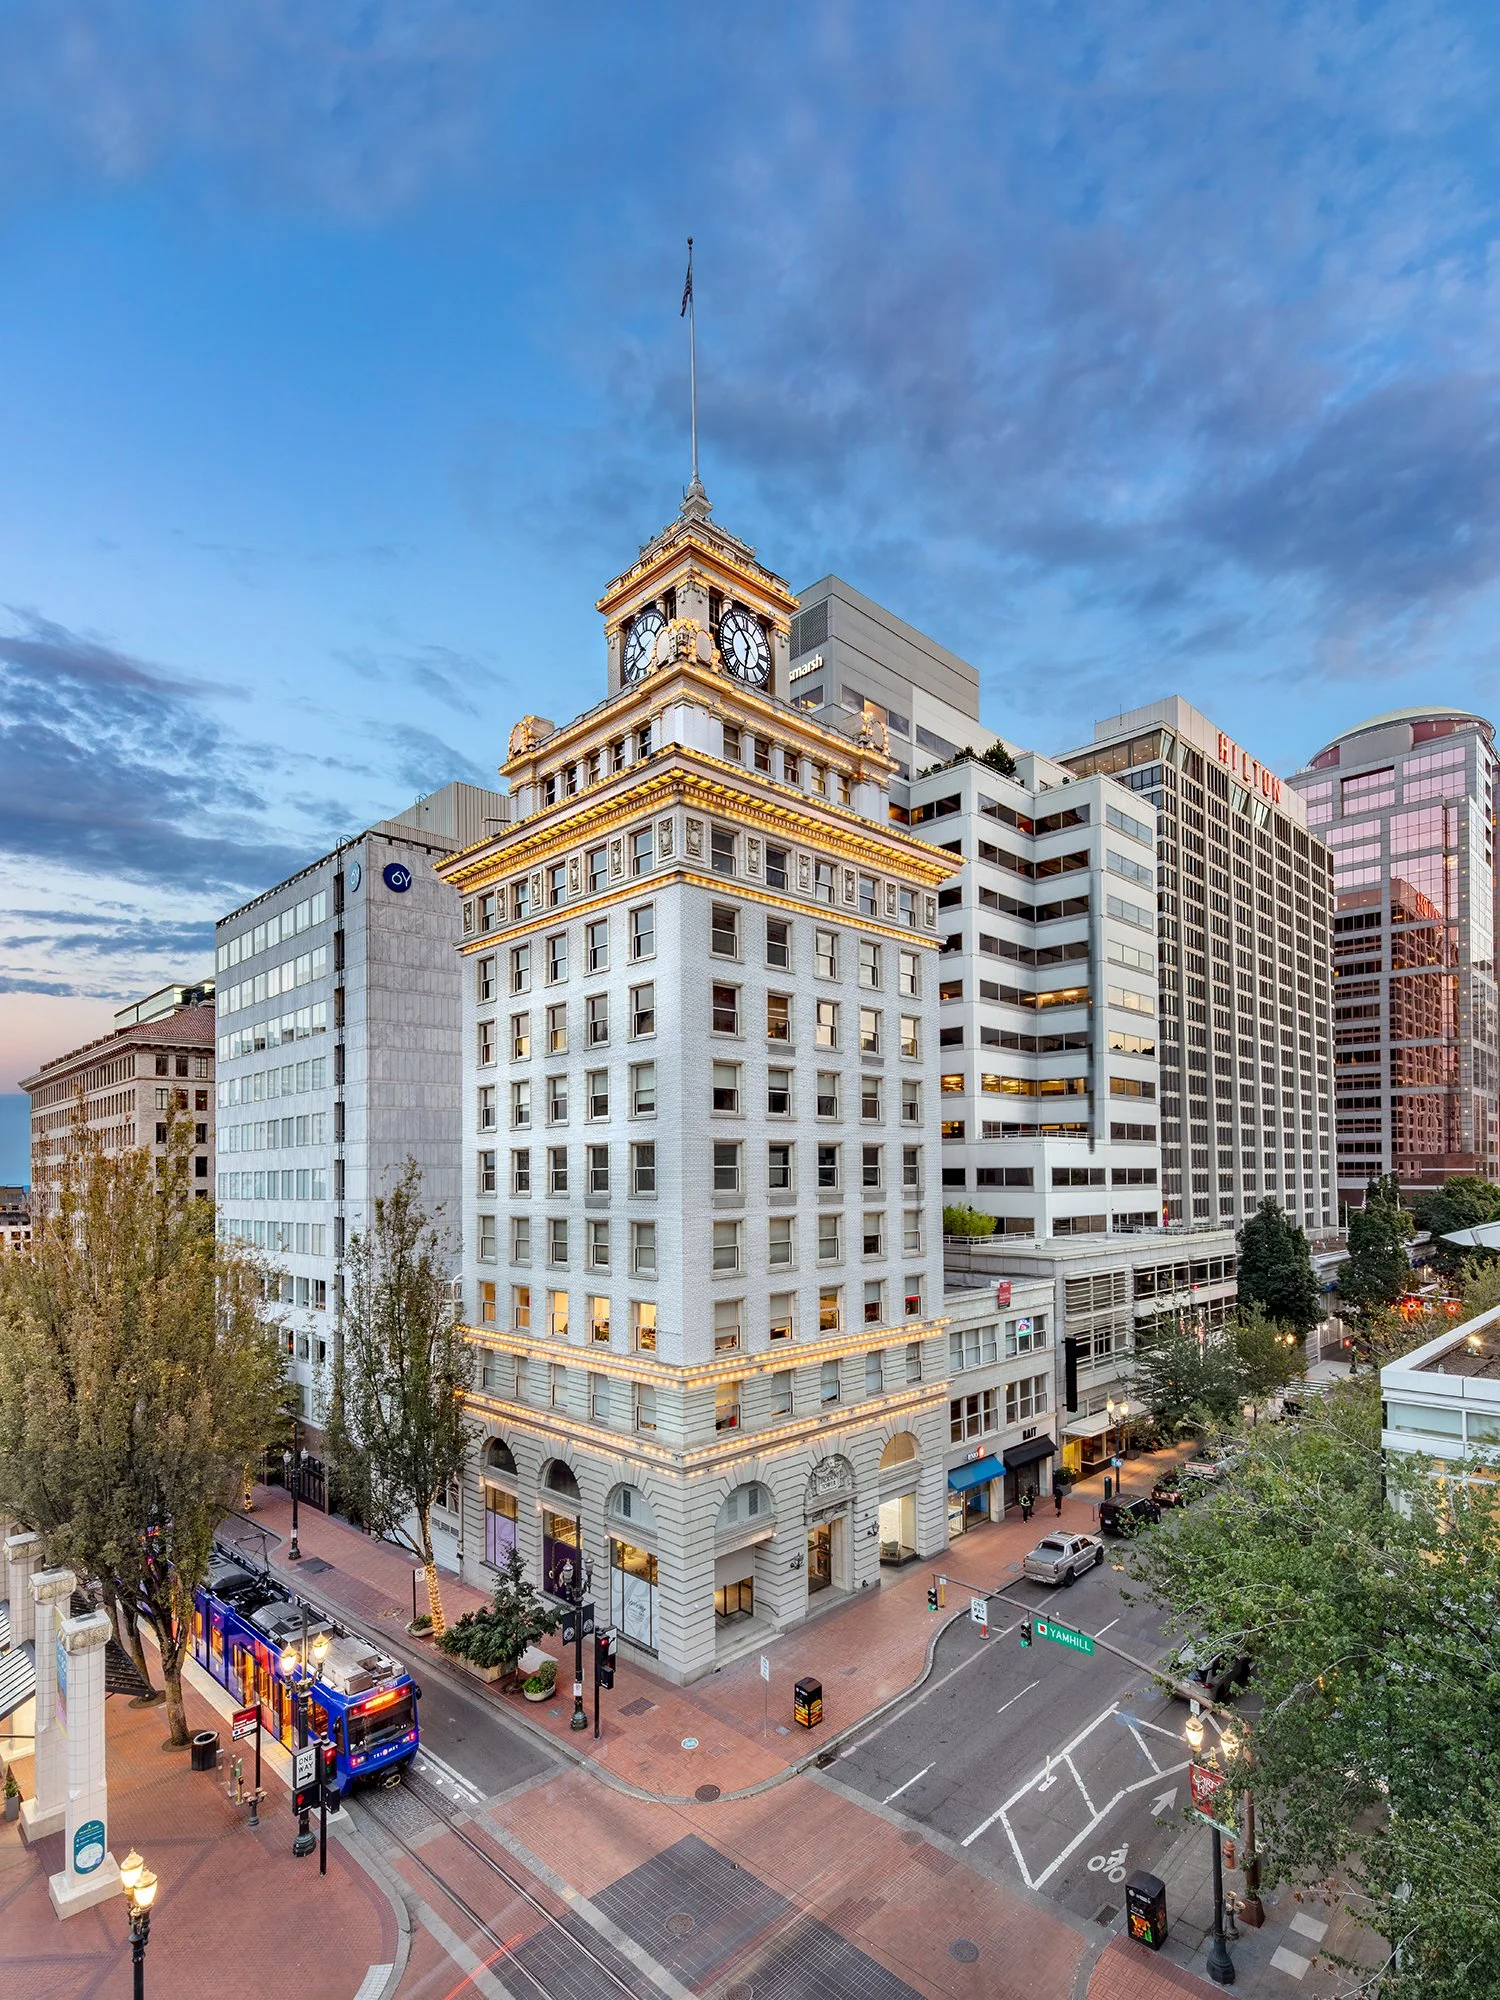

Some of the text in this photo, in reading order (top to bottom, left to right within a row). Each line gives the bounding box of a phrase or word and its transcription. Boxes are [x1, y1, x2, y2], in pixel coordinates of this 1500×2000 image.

[789, 653, 823, 681] smarsh
[1219, 731, 1281, 804] HILTON
[973, 1600, 985, 1609] ONE
[973, 1607, 985, 1615] WAY
[1049, 1627, 1091, 1652] YAMHILL
[298, 1753, 313, 1765] ONE
[298, 1762, 314, 1773] WAY
